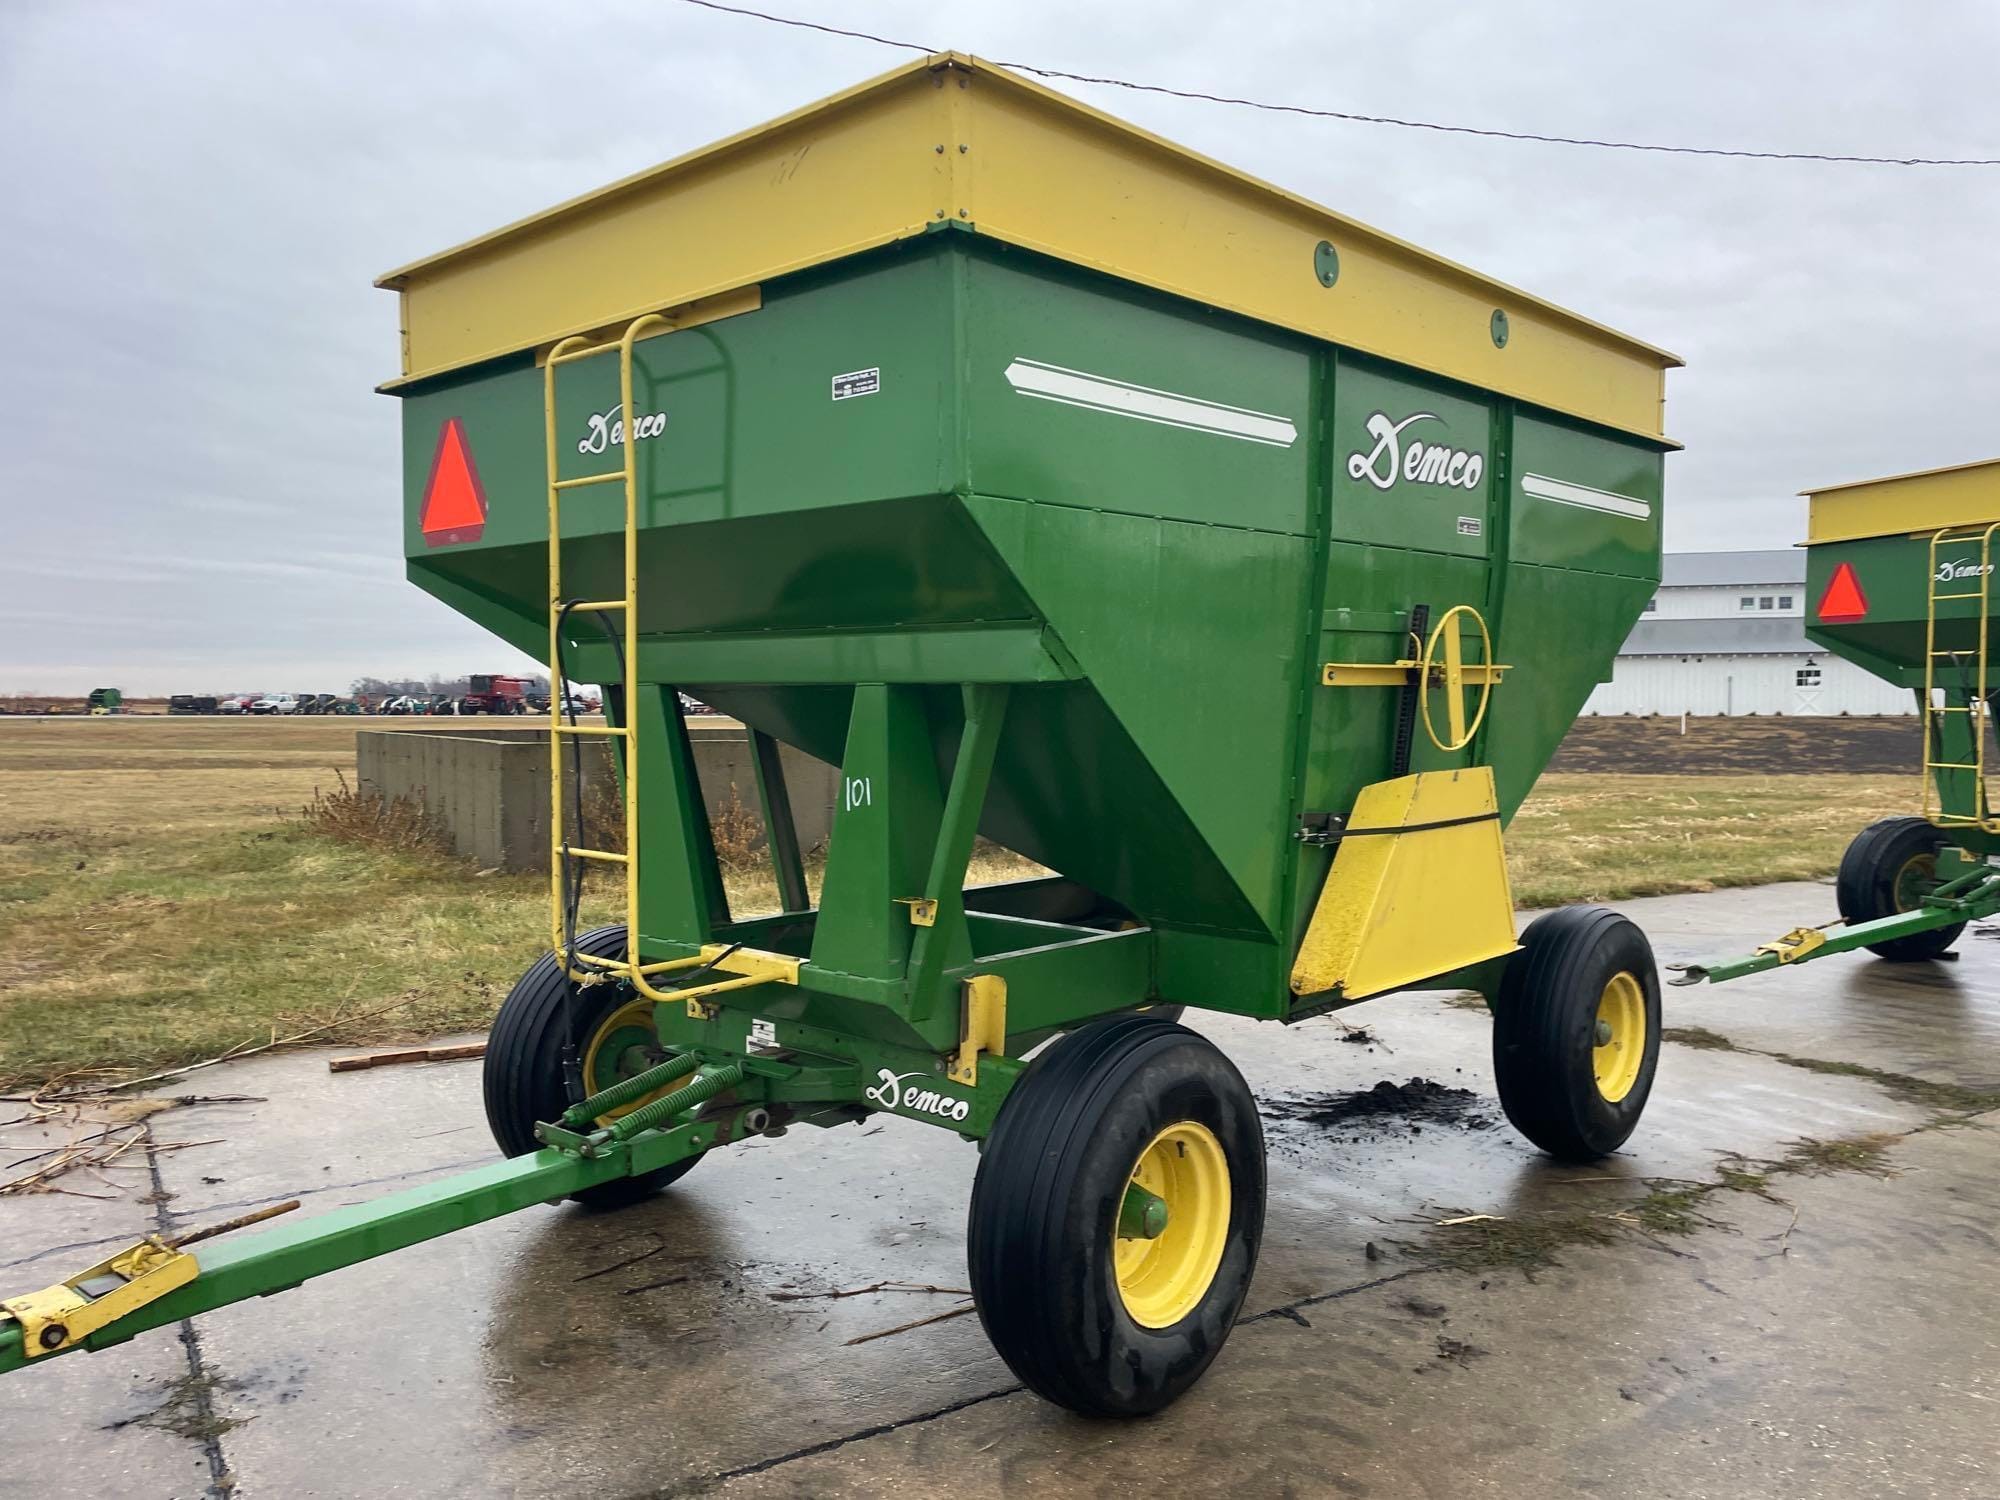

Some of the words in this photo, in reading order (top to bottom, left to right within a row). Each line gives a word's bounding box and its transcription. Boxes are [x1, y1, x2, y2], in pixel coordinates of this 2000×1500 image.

[1347, 411, 1484, 491] Demco
[1934, 557, 1995, 582] Demco
[846, 776, 871, 812] 101
[865, 1068, 970, 1122] Demco
